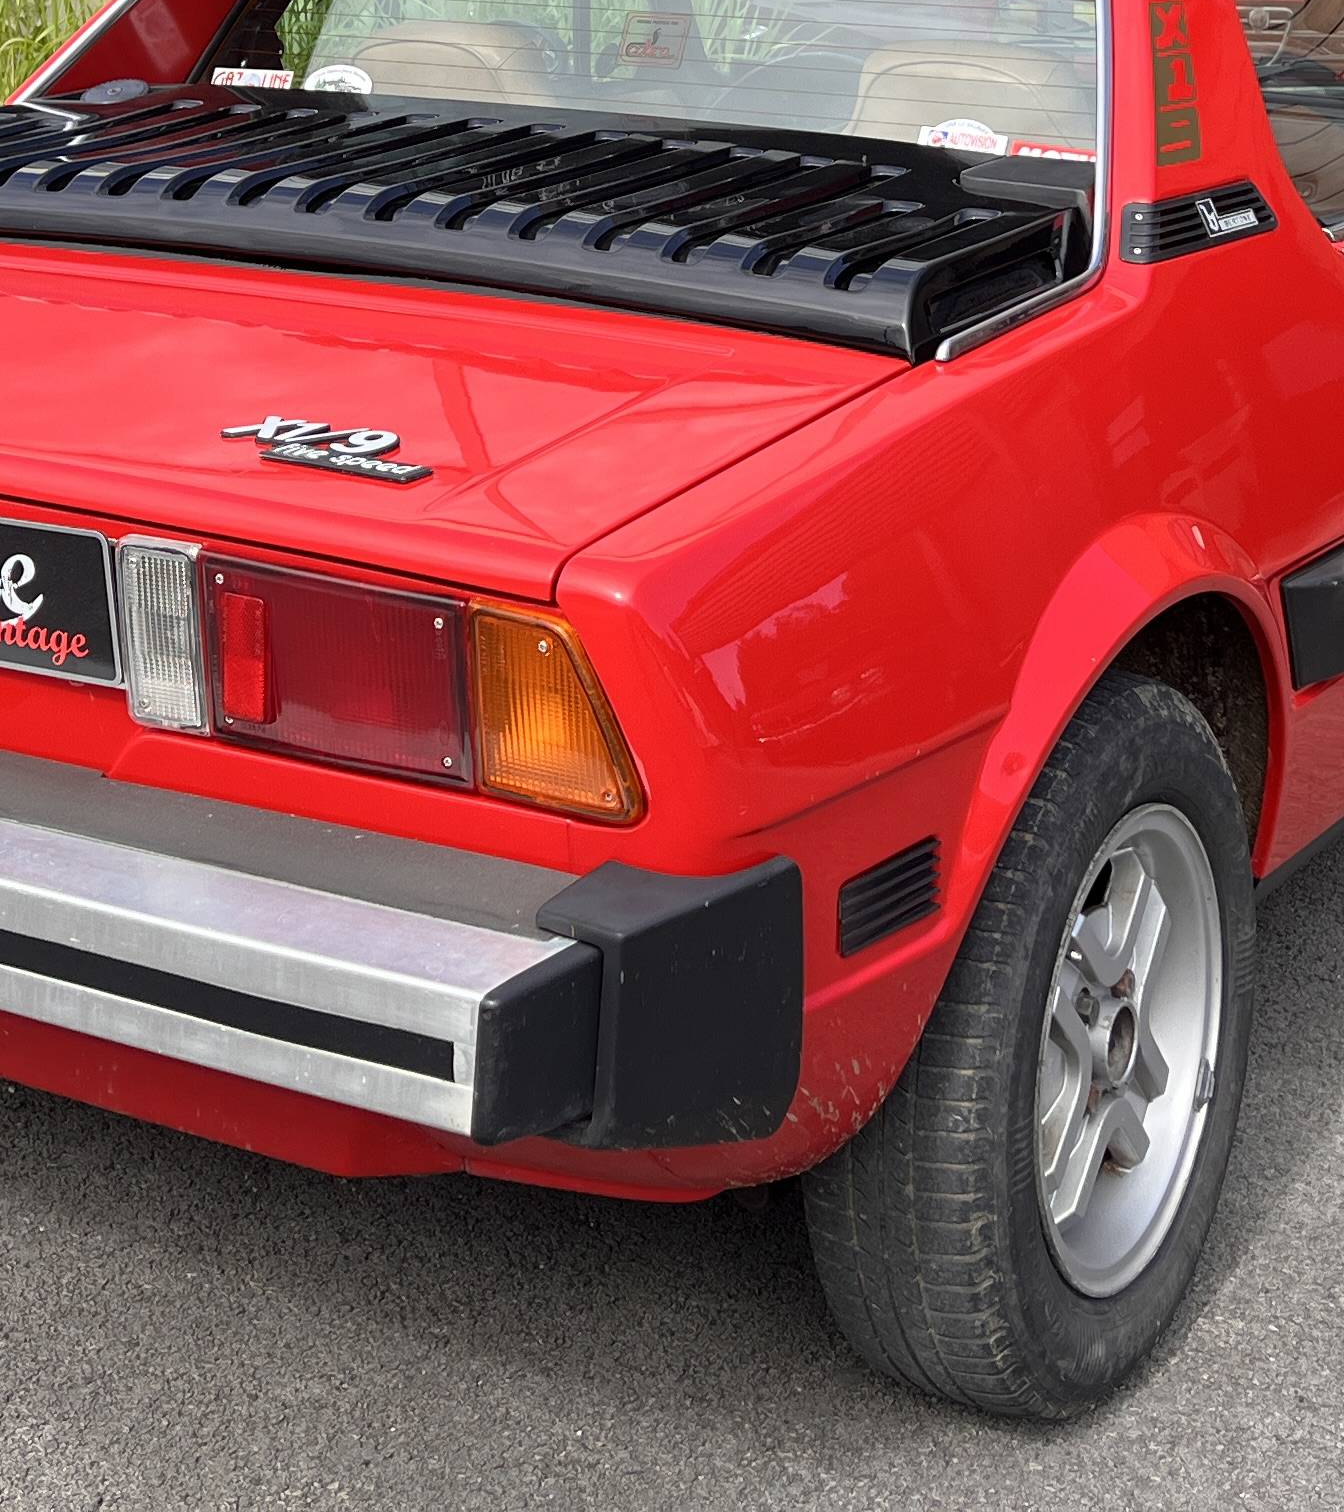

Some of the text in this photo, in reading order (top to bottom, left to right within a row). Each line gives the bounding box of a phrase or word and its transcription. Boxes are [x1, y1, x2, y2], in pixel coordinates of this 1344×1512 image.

[221, 416, 400, 455] X1/9
[270, 443, 426, 475] five speed
